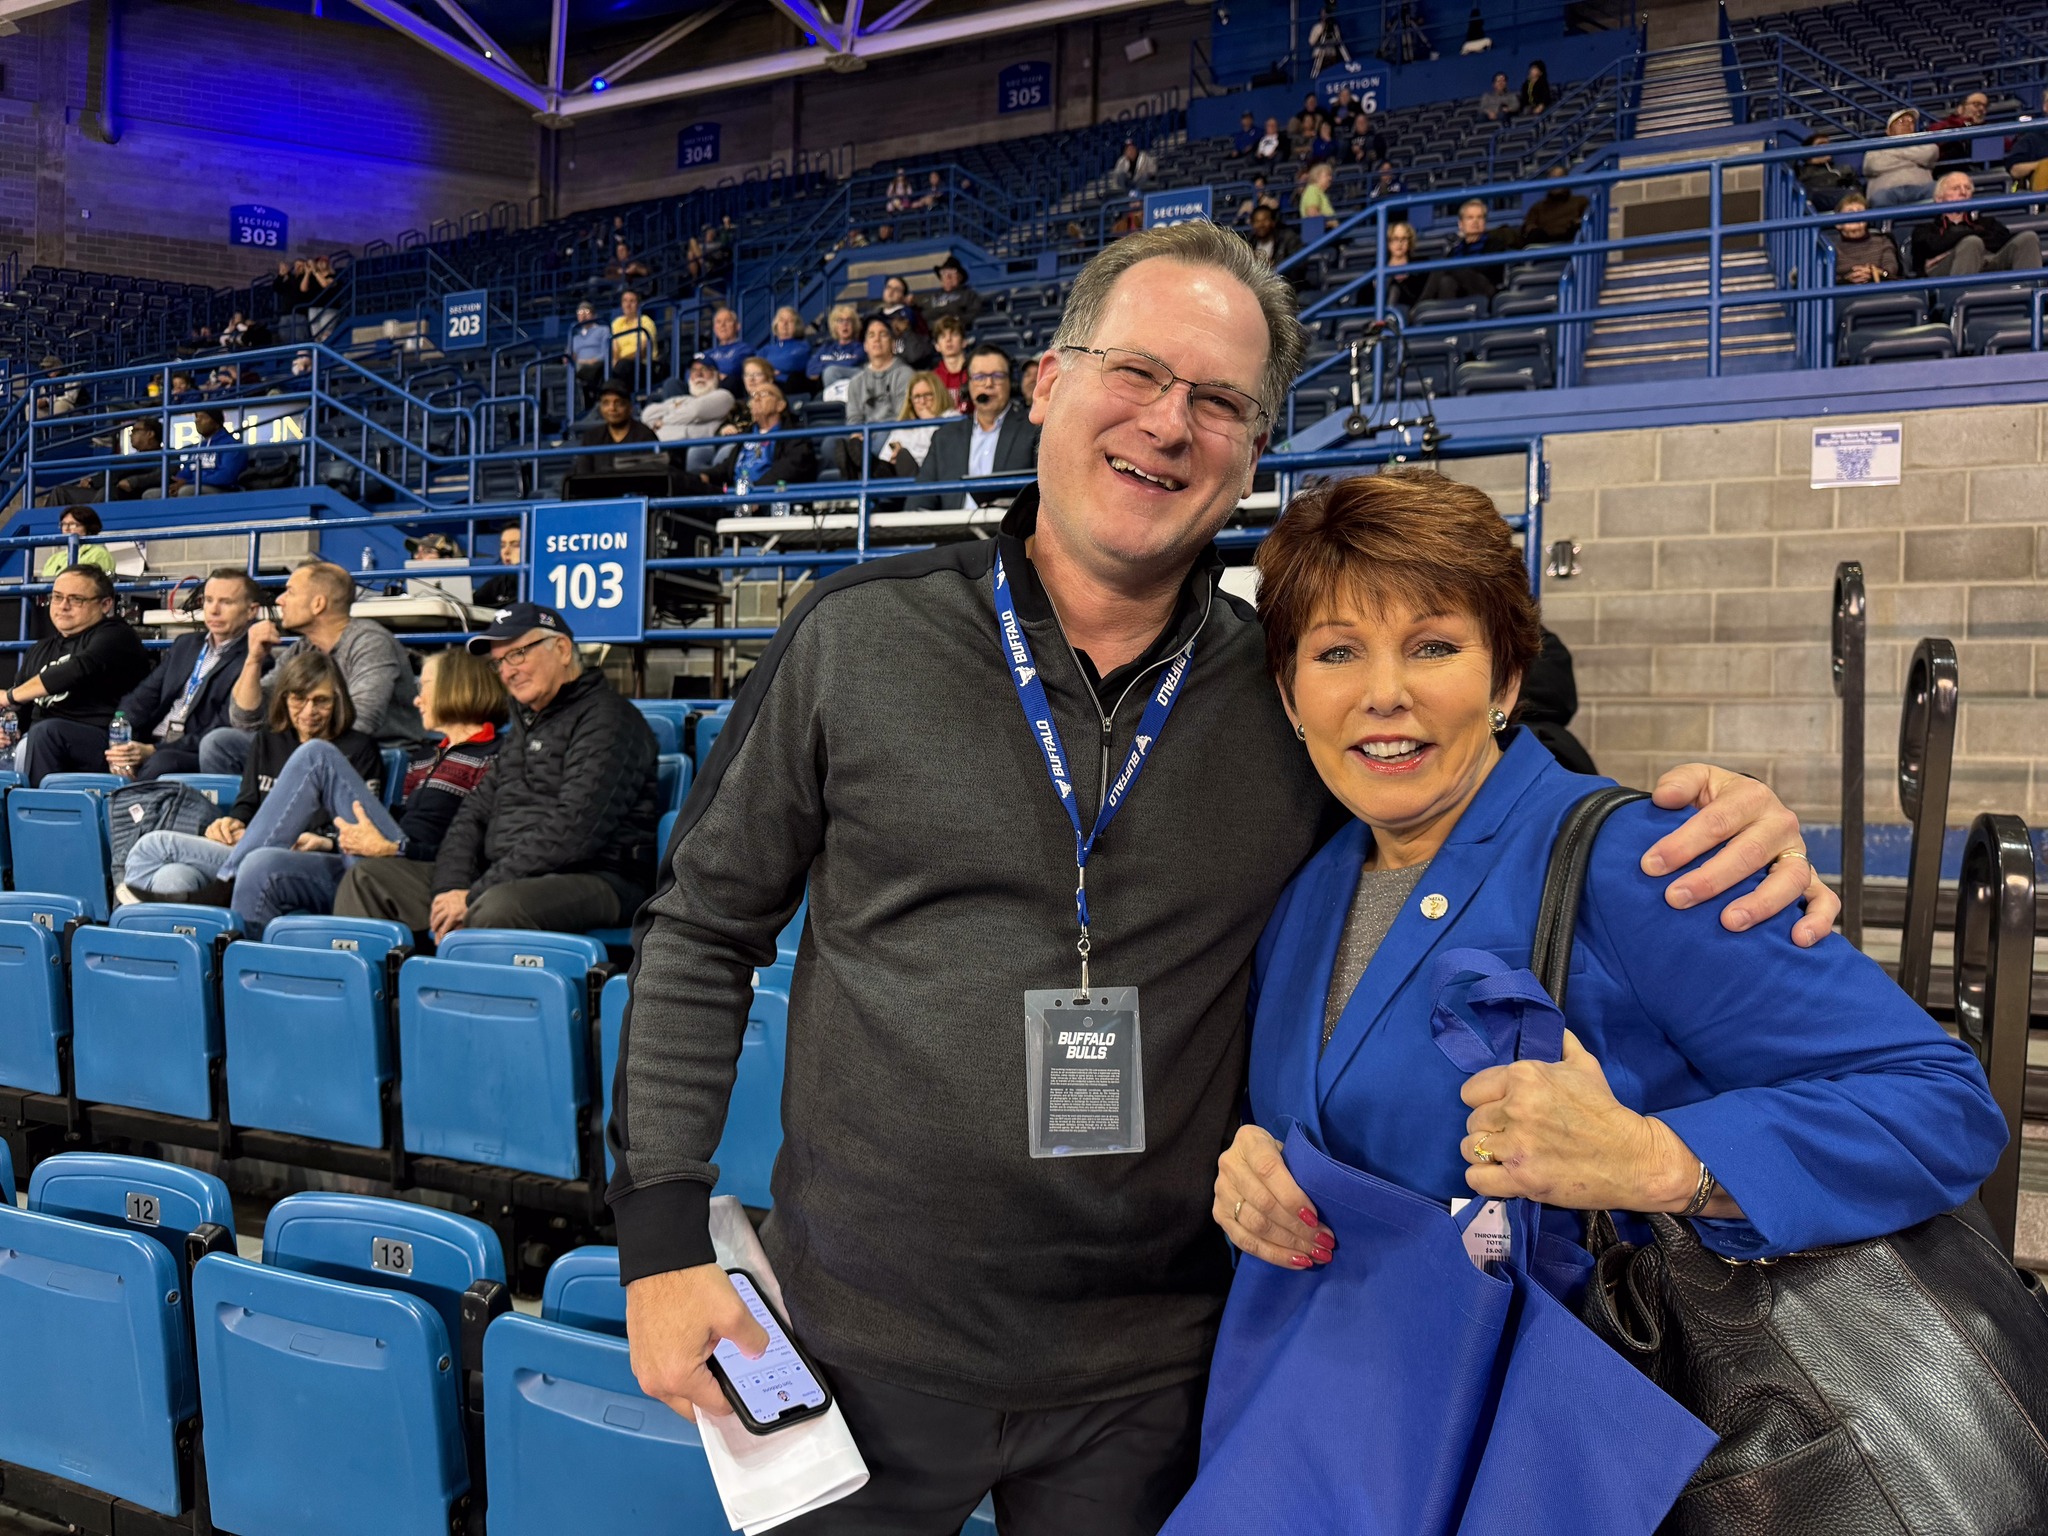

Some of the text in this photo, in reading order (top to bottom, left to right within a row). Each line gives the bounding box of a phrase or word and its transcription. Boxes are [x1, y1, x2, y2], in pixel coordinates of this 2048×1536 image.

[1007, 85, 1041, 108] 305
[684, 144, 713, 165] 304
[1153, 202, 1203, 219] SECTION
[240, 226, 277, 247] 303
[448, 314, 480, 338] 203
[546, 531, 628, 553] SECTION
[548, 561, 624, 610] 103
[1001, 609, 1028, 664] BUFFALO
[1155, 654, 1188, 707] BUFFALO
[1036, 719, 1066, 777] BUFFALO
[1108, 750, 1141, 807] BUFFALO
[39, 915, 47, 928] 9
[1058, 1031, 1116, 1046] BUFFALO
[1066, 1046, 1108, 1060] BULLS
[133, 1198, 153, 1220] 12
[1474, 1232, 1511, 1240] THROWBAC
[381, 1243, 404, 1269] 13
